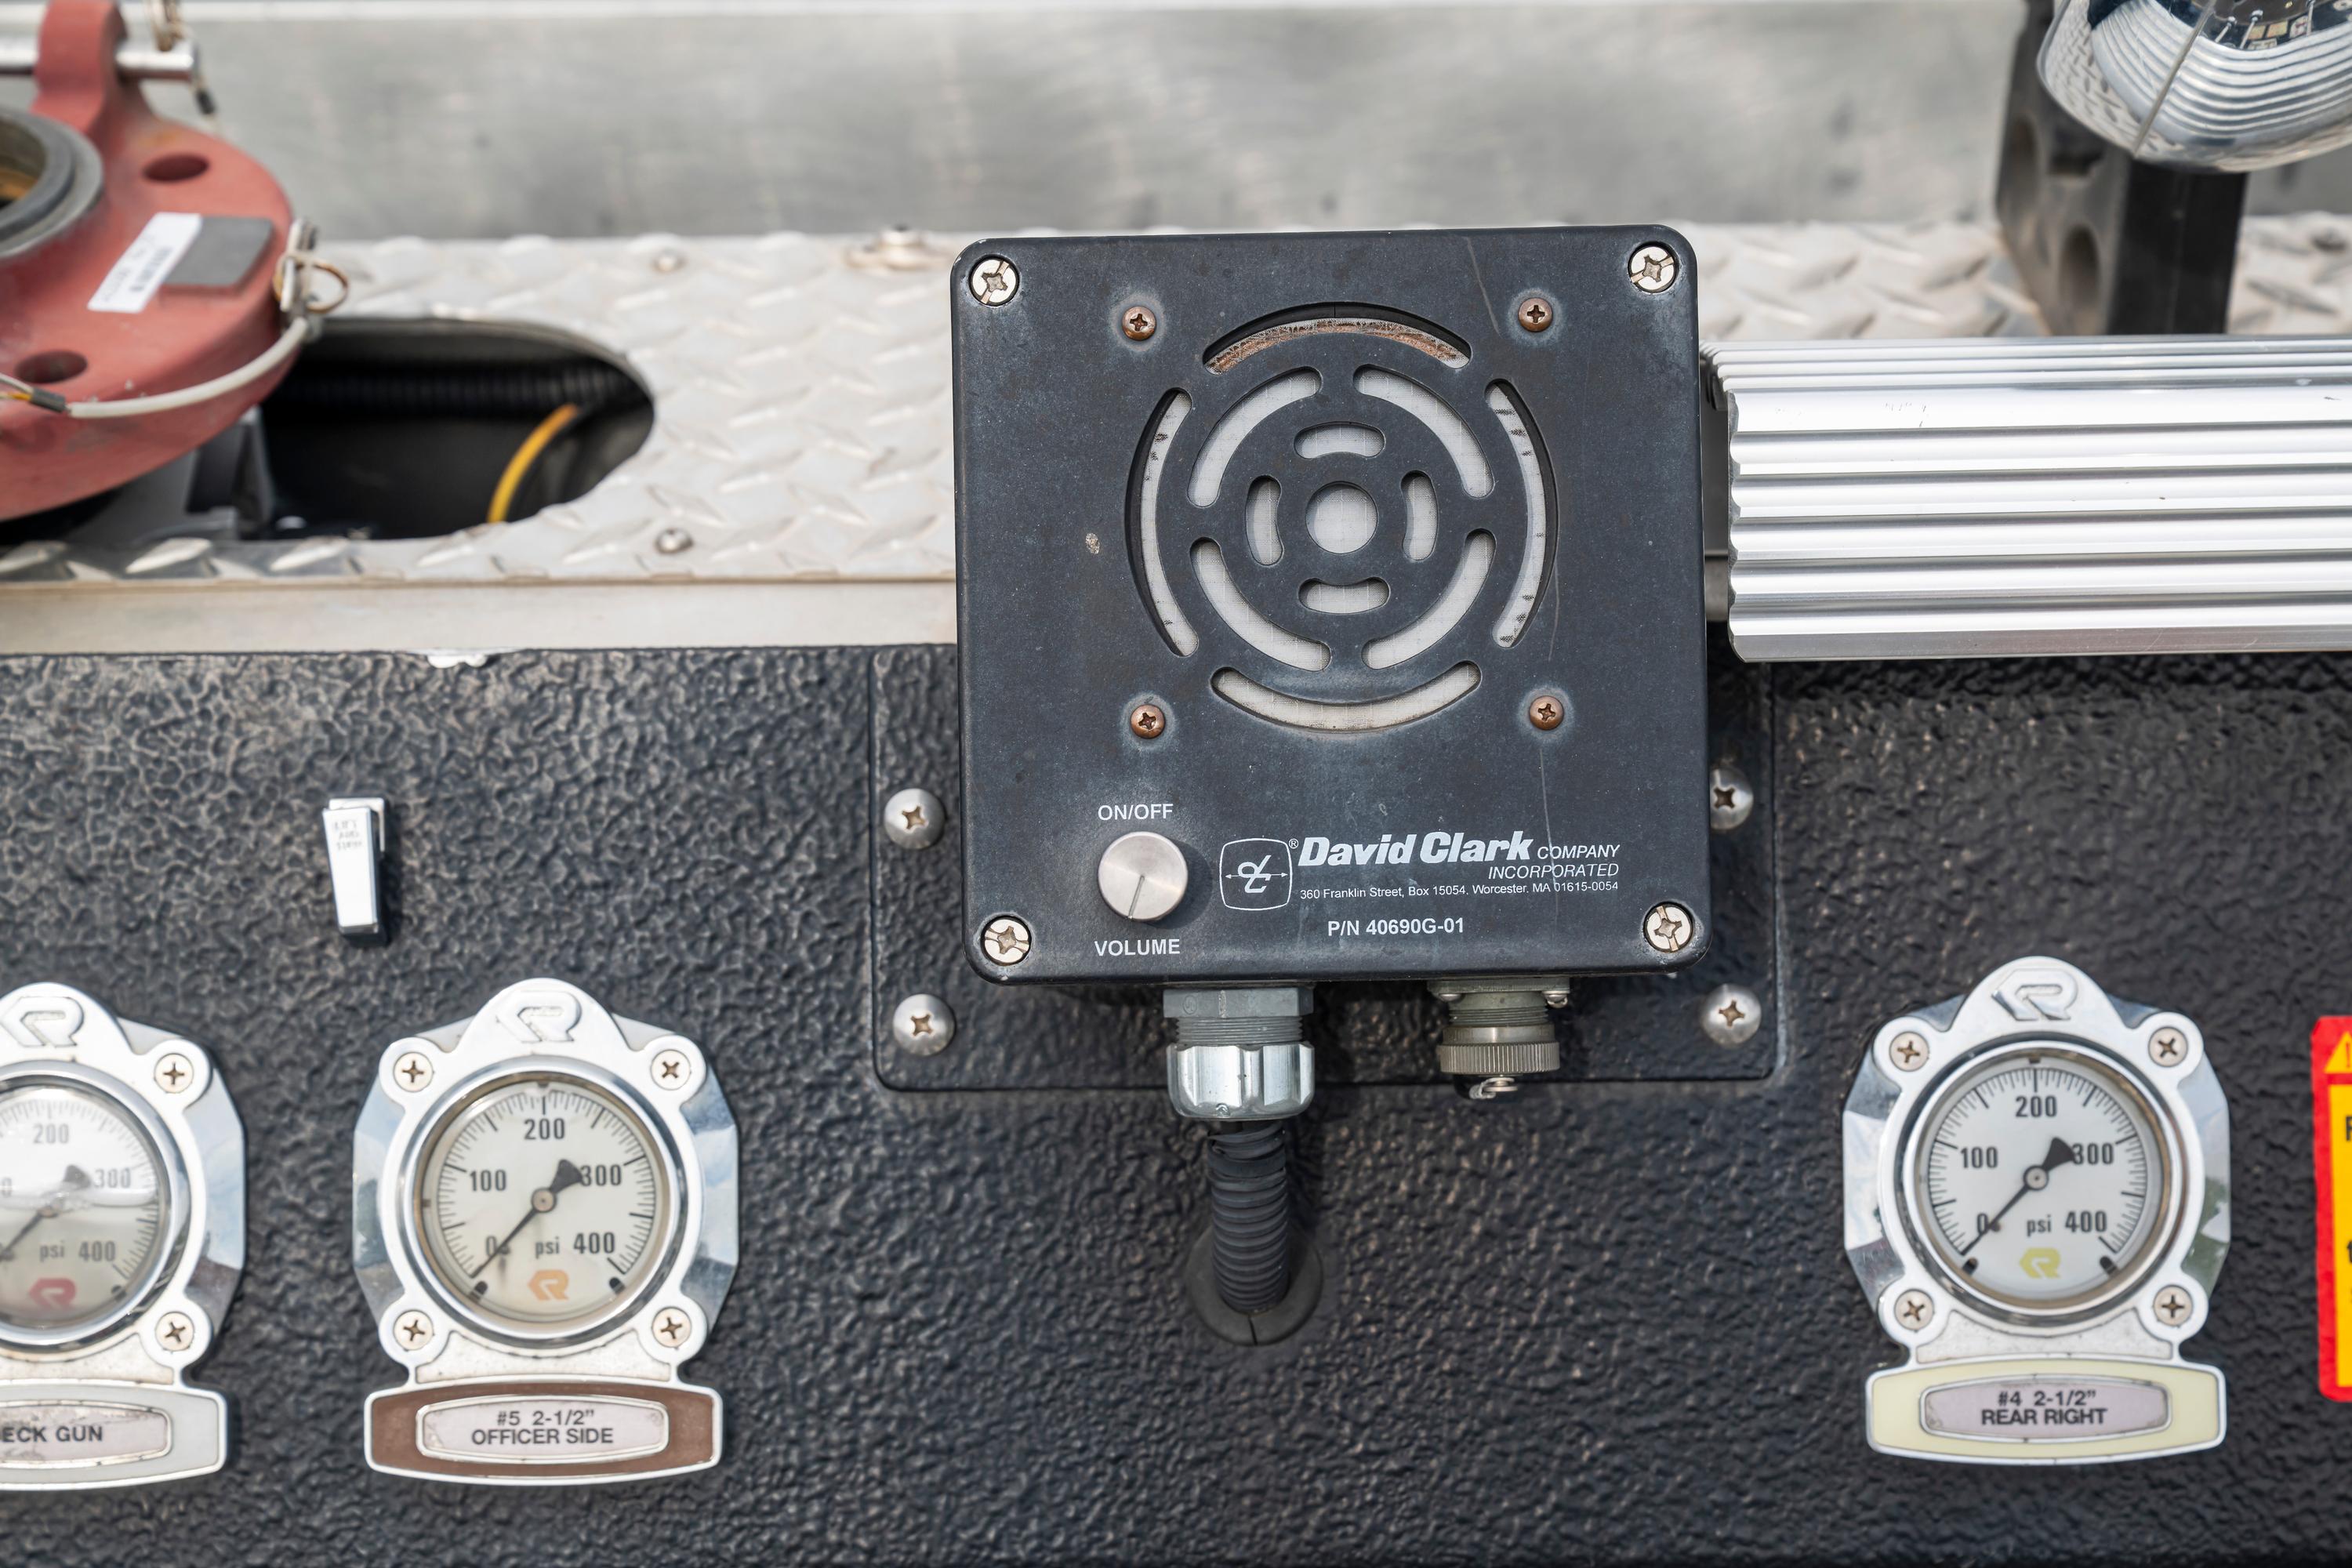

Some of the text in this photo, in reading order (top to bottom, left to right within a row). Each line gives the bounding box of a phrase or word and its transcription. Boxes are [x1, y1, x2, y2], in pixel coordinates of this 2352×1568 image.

[1098, 804, 1174, 821] ON/OFF
[1298, 830, 1621, 866] David Clark COMPANY
[1488, 863, 1619, 880] INCORPORATED
[1300, 889, 1320, 899] 360
[1323, 887, 1367, 898] Franklin
[1369, 887, 1405, 898] Street,
[1408, 886, 1429, 896] Box
[1533, 883, 1551, 892] MA
[1554, 881, 1618, 892] 01615-0054
[1327, 917, 1464, 936] P/N 40690G-01
[1094, 938, 1181, 956] VOLUME
[2015, 1095, 2057, 1117] 200
[33, 1123, 70, 1144] 200
[524, 1118, 565, 1140] 200
[1960, 1146, 1998, 1168] 100
[2071, 1142, 2114, 1165] 300
[93, 1167, 132, 1189] 300
[470, 1169, 506, 1191] 100
[580, 1164, 622, 1186] 300
[2026, 1210, 2107, 1236] psi 400
[40, 1240, 117, 1262] psi 400
[535, 1232, 615, 1259] psi 400
[1998, 1391, 2021, 1406] #4
[497, 1410, 521, 1425] #5
[1981, 1408, 2107, 1425] REAR RIGHT
[0, 1425, 103, 1443] ECK GUN
[471, 1428, 614, 1445] OFFICER SIDE
